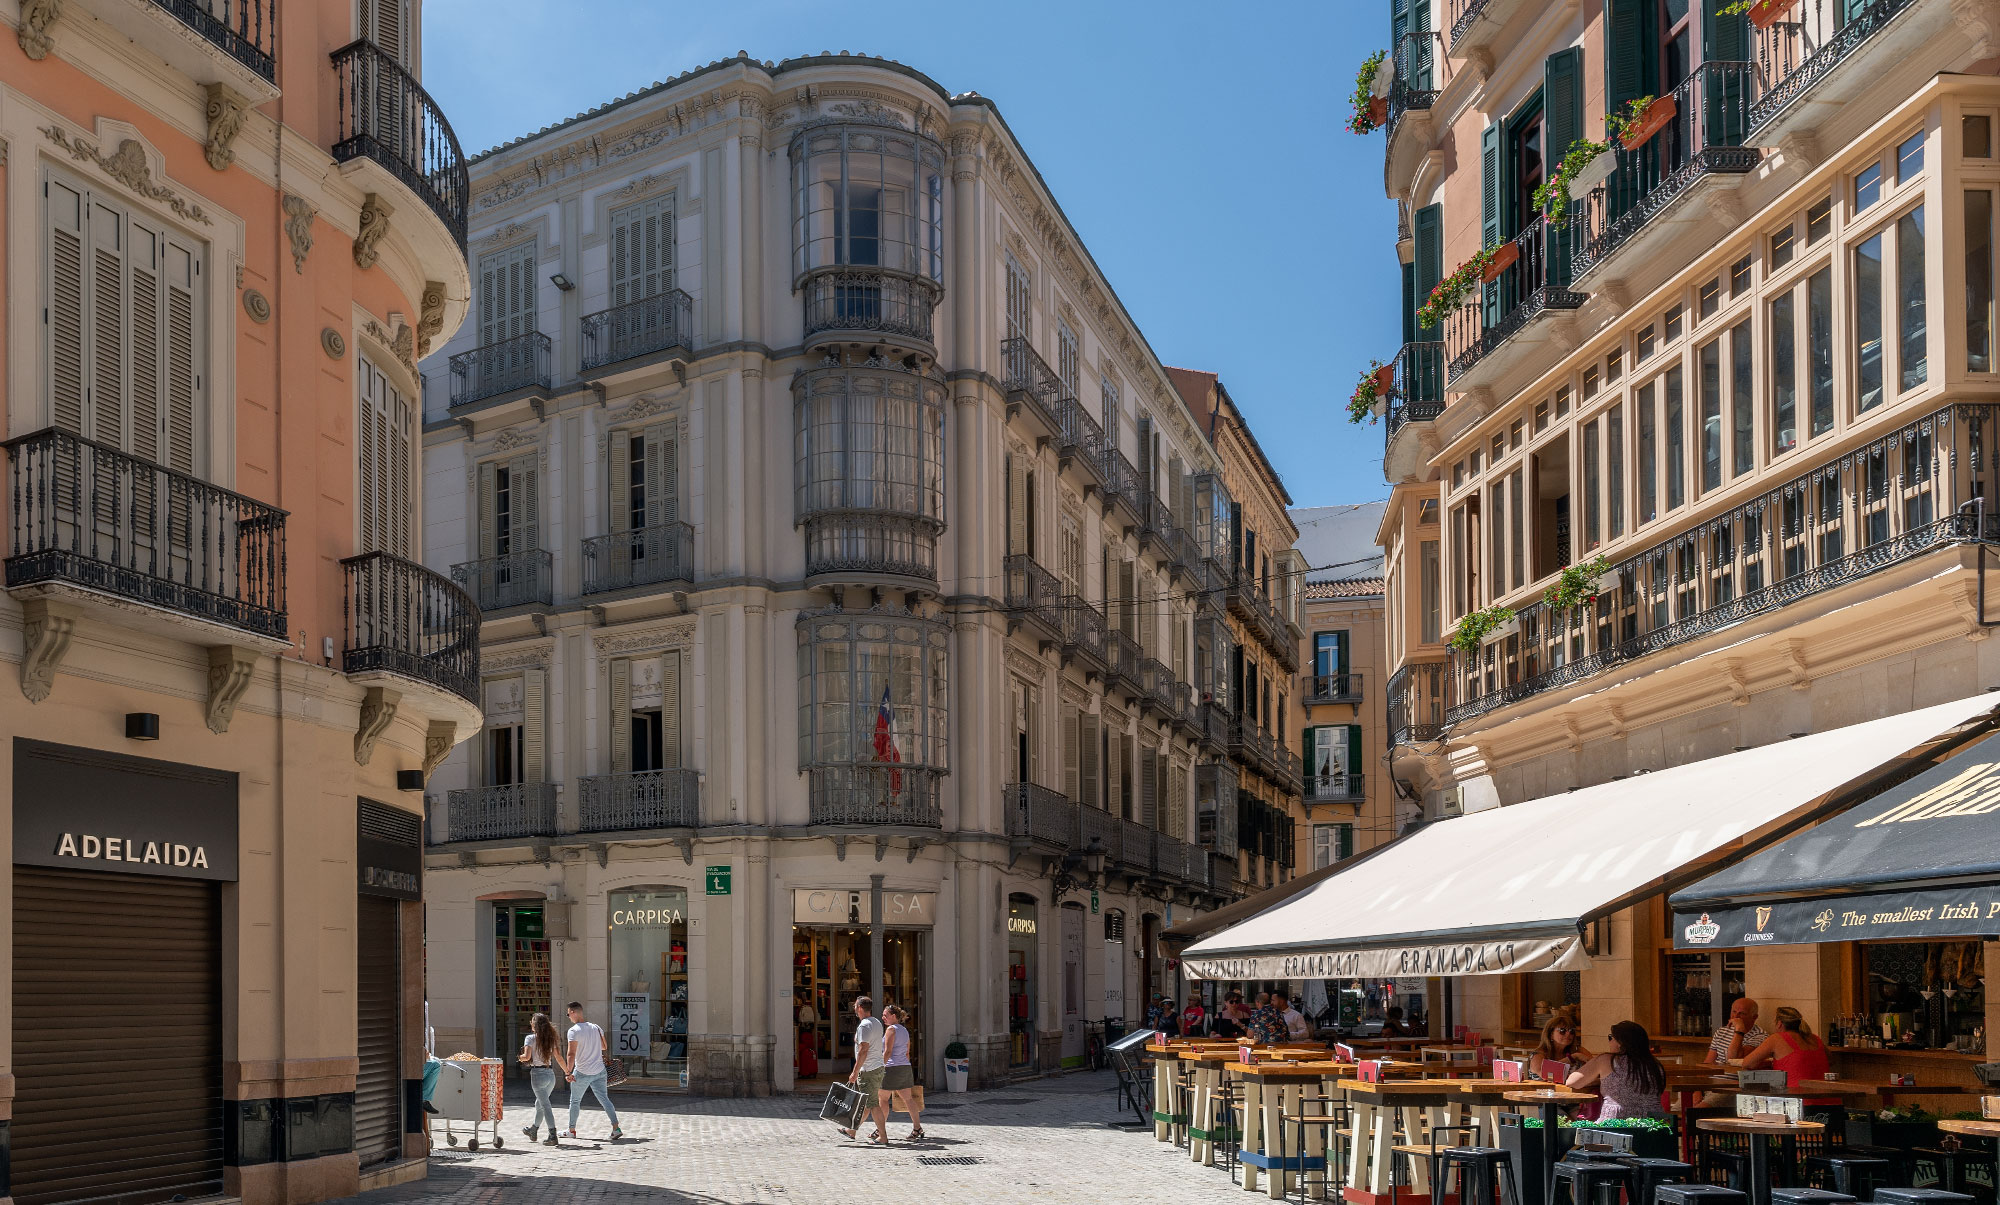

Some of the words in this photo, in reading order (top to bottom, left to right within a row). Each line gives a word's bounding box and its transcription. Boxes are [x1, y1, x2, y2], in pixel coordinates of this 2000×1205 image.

[58, 833, 208, 868] ADELAIDA
[613, 909, 682, 925] CARPISA
[1841, 910, 1867, 927] The
[1871, 906, 1934, 924] smallest
[1938, 901, 1979, 920] Irish
[1008, 917, 1035, 933] CARPISA
[1744, 933, 1774, 941] GUINNESS
[1285, 956, 1342, 976] GRANADA
[1347, 954, 1360, 975] 17
[1401, 947, 1488, 973] GRANADA
[1495, 944, 1515, 970] 17
[1201, 961, 1245, 977] GRANADA
[1248, 959, 1257, 977] 17
[620, 1014, 638, 1031] 25
[620, 1034, 639, 1051] 50
